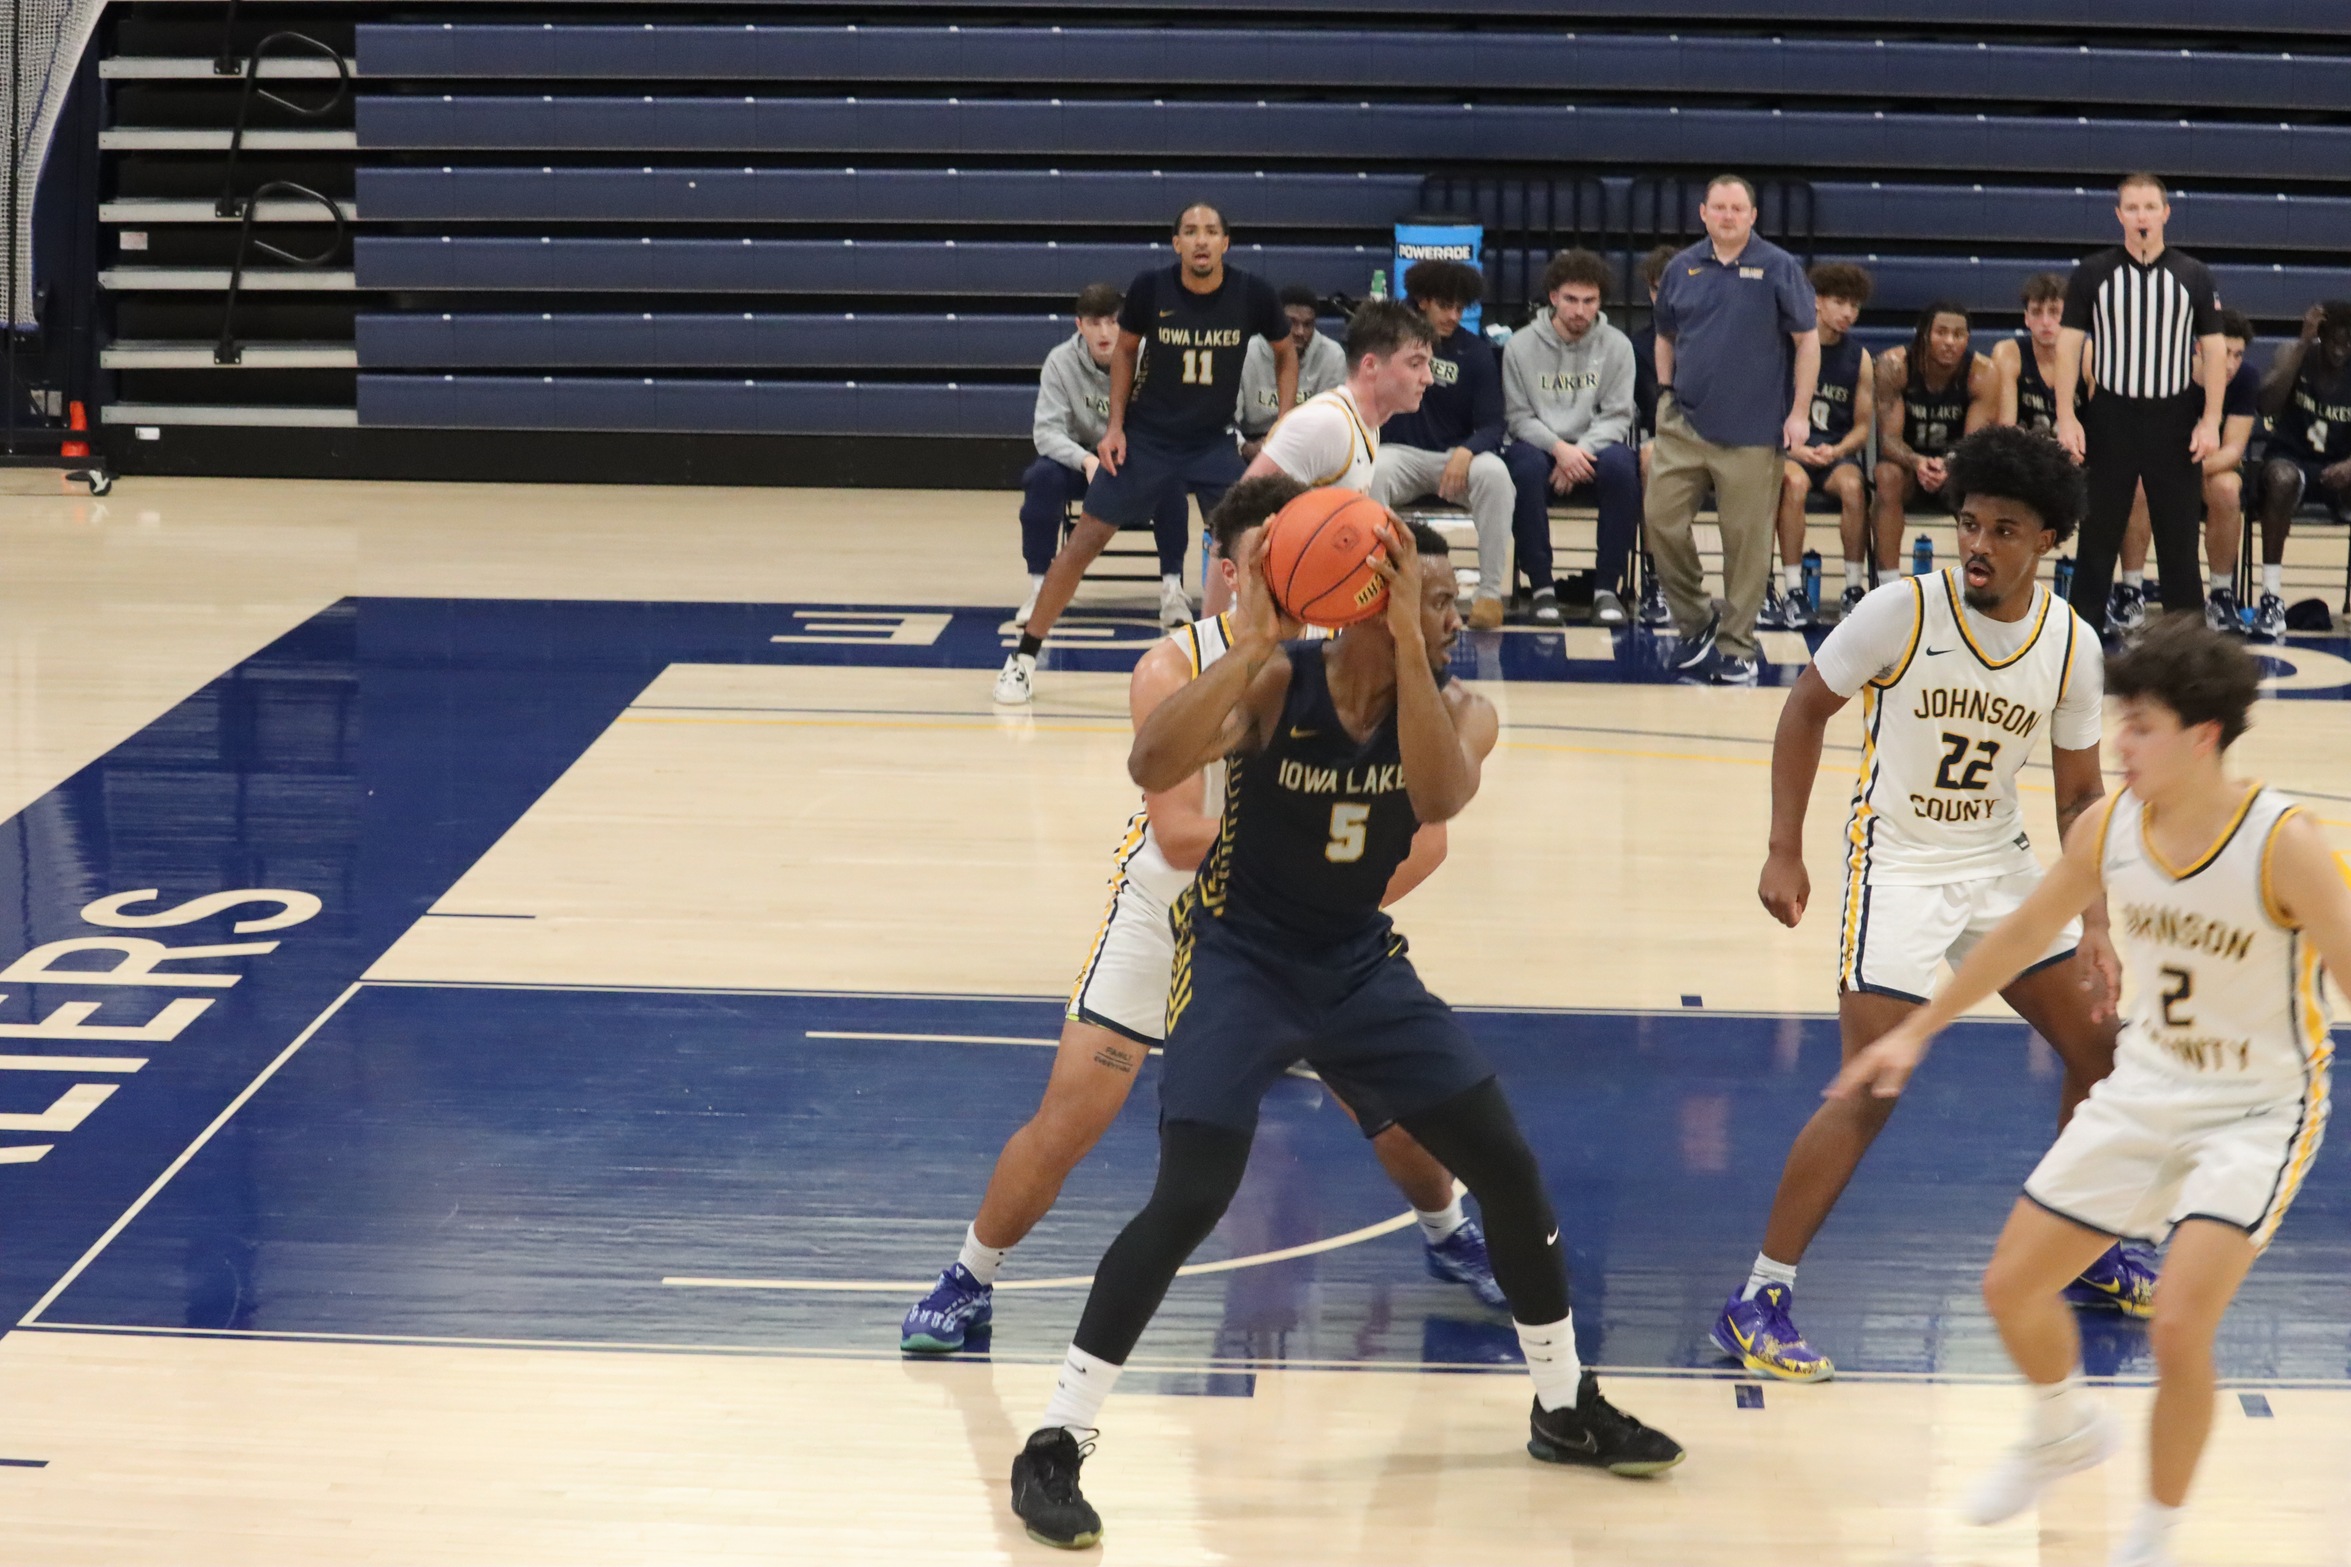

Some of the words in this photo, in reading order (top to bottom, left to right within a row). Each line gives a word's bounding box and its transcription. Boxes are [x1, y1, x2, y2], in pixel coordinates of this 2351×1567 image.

[1398, 244, 1471, 260] POWERADE
[1158, 327, 1191, 345] IOWA
[1195, 329, 1241, 347] LAKES
[1182, 349, 1213, 386] 11
[1913, 687, 2043, 739] JOHNSON
[1277, 757, 1339, 795] IOWA
[1345, 763, 1406, 796] LAKE
[1933, 731, 2002, 791] 22
[1909, 793, 2002, 823] COUNY
[1324, 801, 1372, 863] 5
[2158, 961, 2194, 1027] 2
